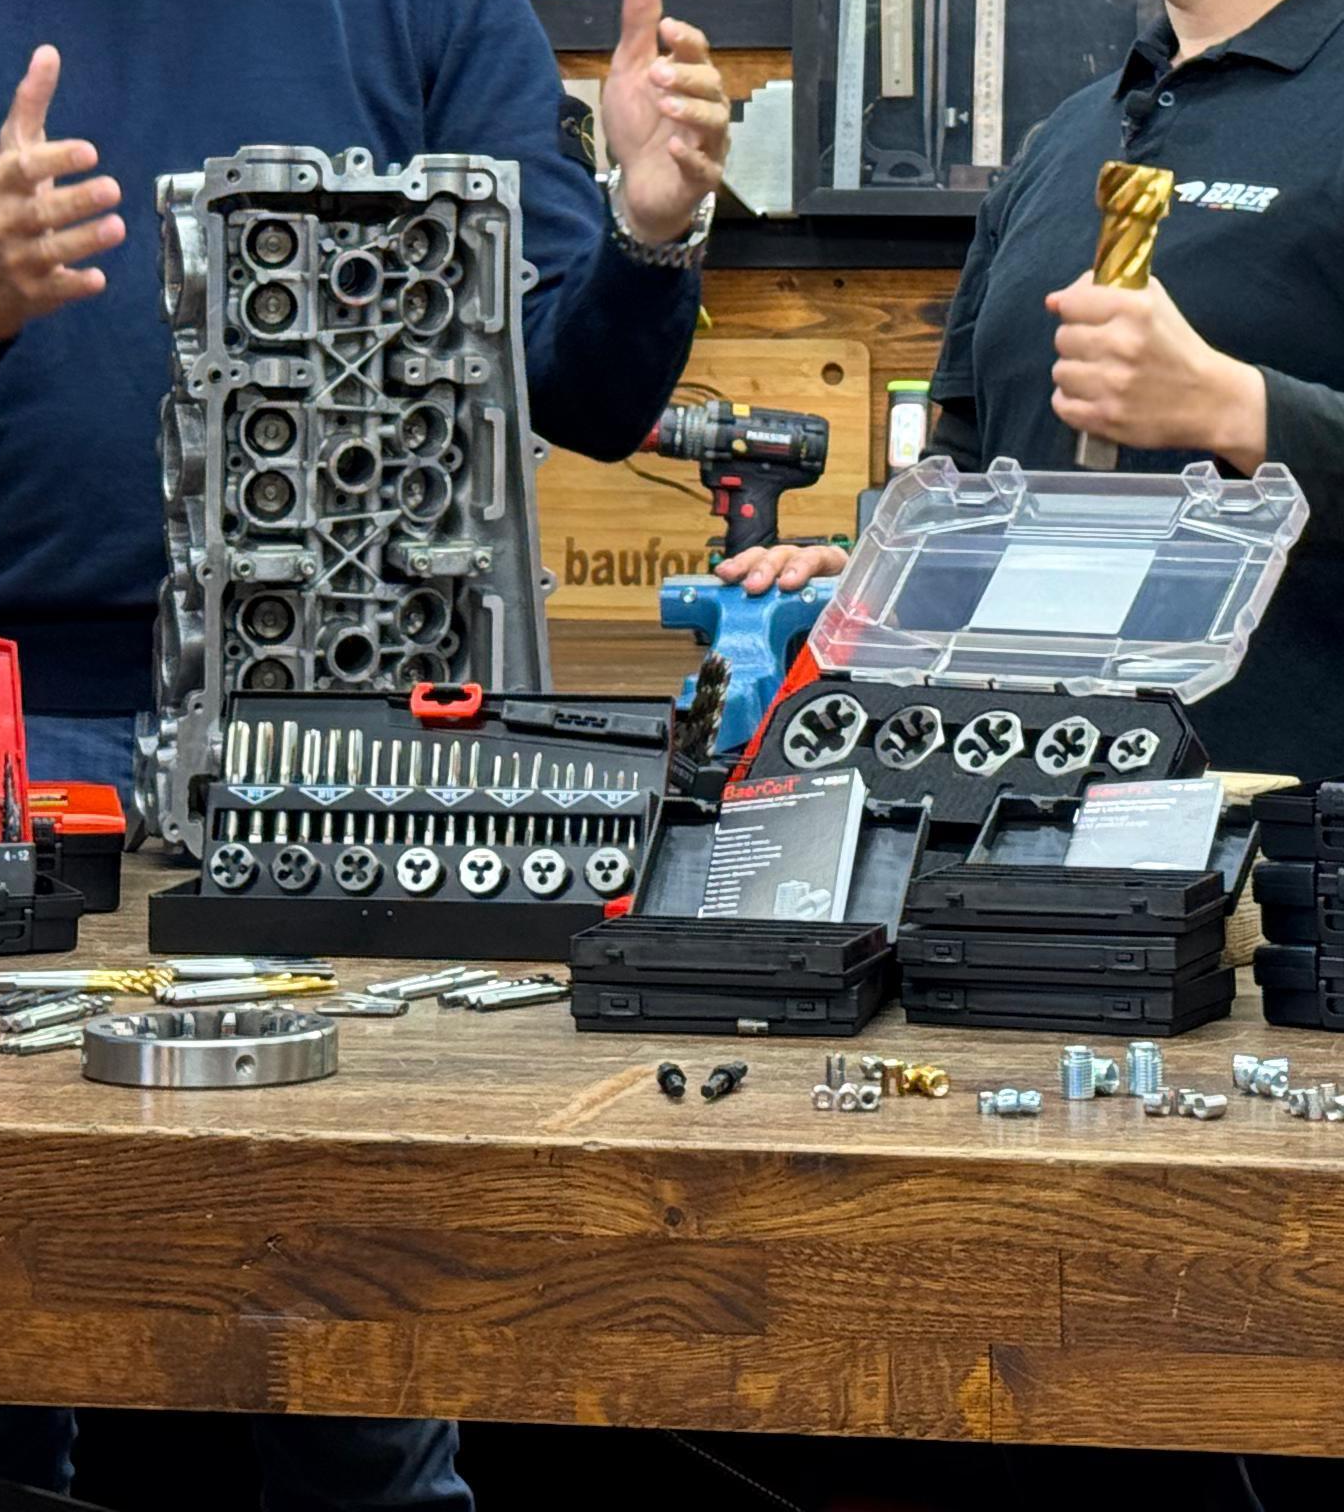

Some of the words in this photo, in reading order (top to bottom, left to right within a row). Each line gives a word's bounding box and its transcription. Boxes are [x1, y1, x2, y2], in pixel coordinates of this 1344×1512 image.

[1200, 182, 1280, 207] BAER
[746, 430, 792, 445] PARKSIDE
[565, 536, 706, 586] baufor
